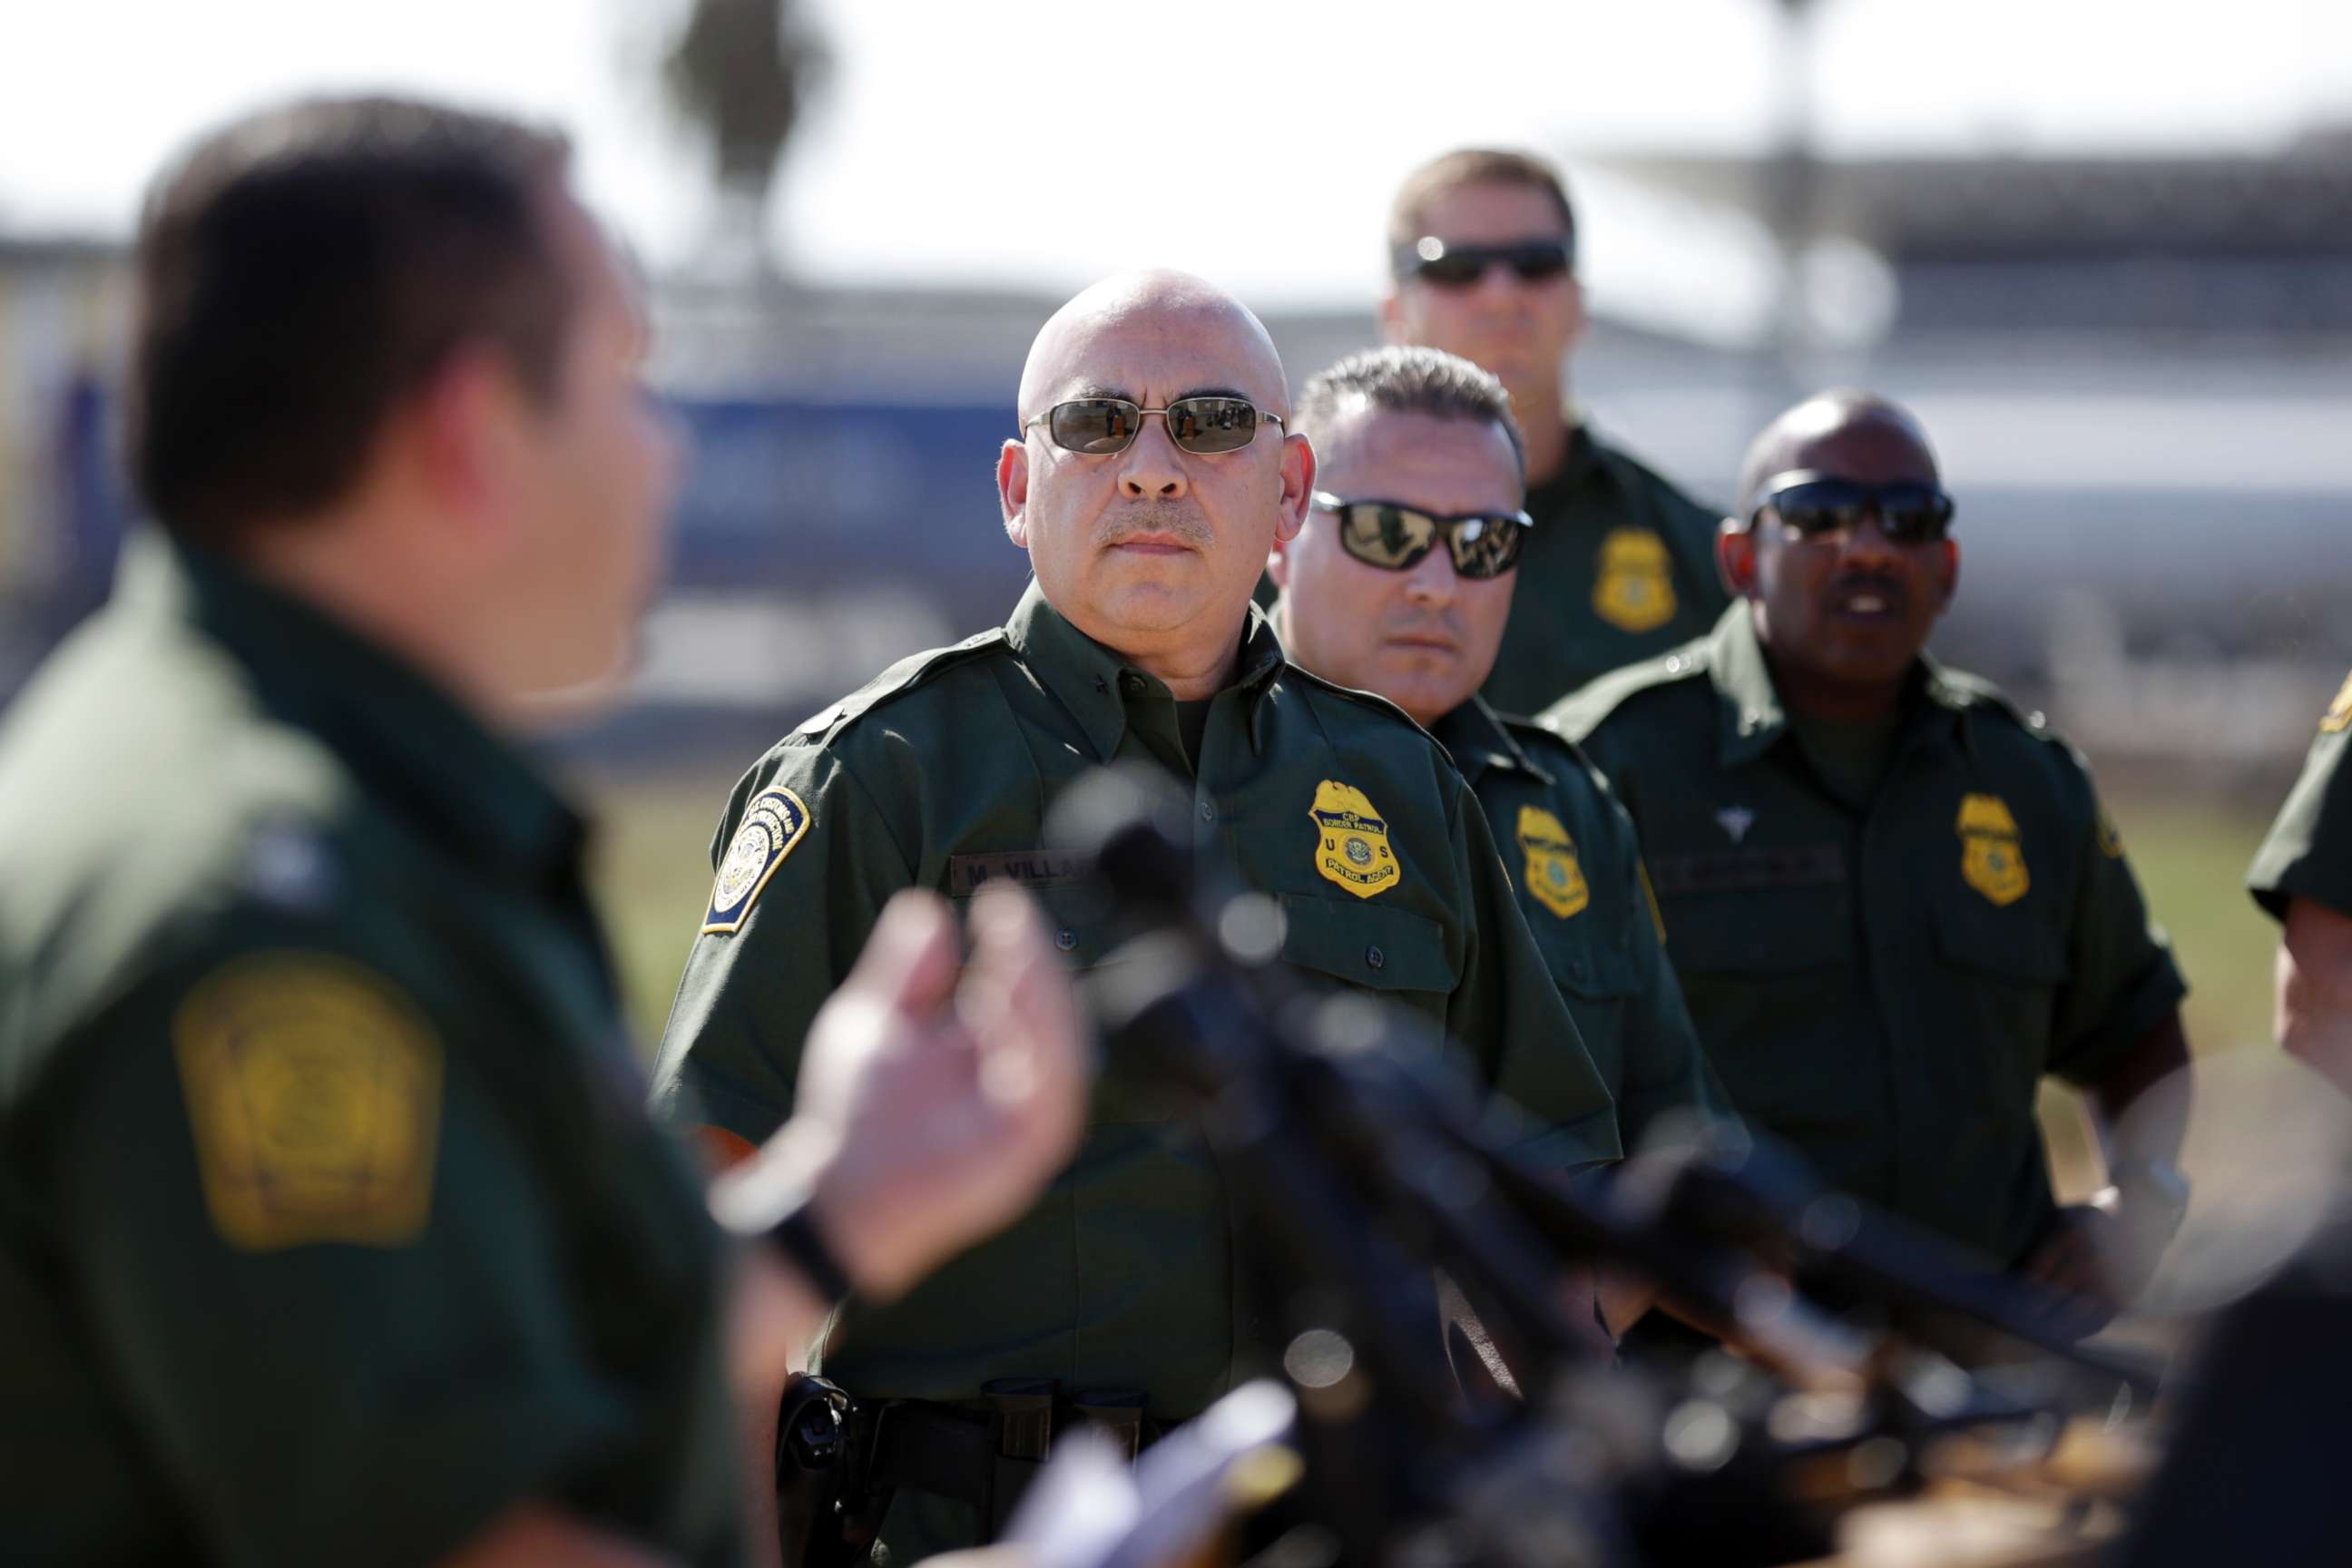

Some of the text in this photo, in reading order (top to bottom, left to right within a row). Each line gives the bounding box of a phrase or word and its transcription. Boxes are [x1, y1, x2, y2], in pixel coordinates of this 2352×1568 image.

[1342, 812, 1360, 822] CBP
[1354, 822, 1384, 835] PATROL
[1326, 838, 1335, 851] U
[1379, 846, 1389, 858] S
[1327, 858, 1394, 884] PATROL AGENT
